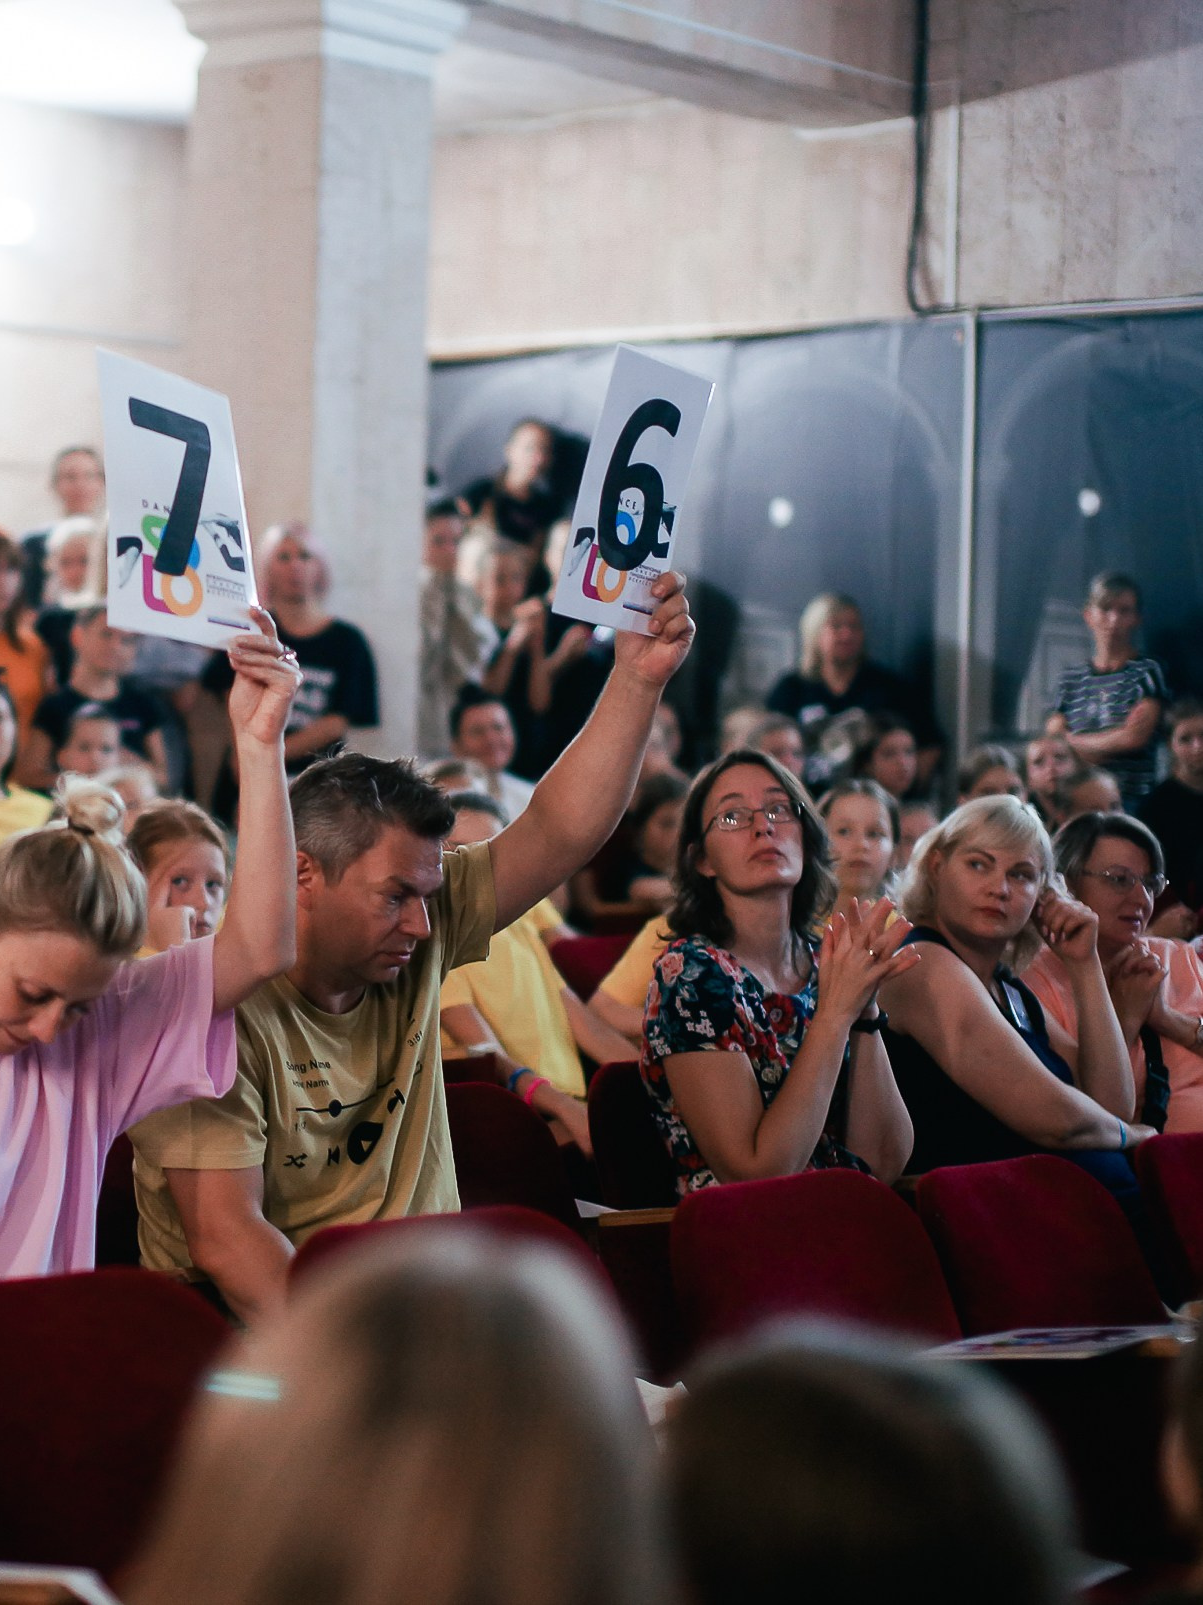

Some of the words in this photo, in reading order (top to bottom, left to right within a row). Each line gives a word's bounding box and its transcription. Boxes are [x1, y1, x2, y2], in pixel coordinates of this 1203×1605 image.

[128, 396, 211, 577] 7
[141, 499, 171, 515] DAN
[597, 398, 682, 571] 6
